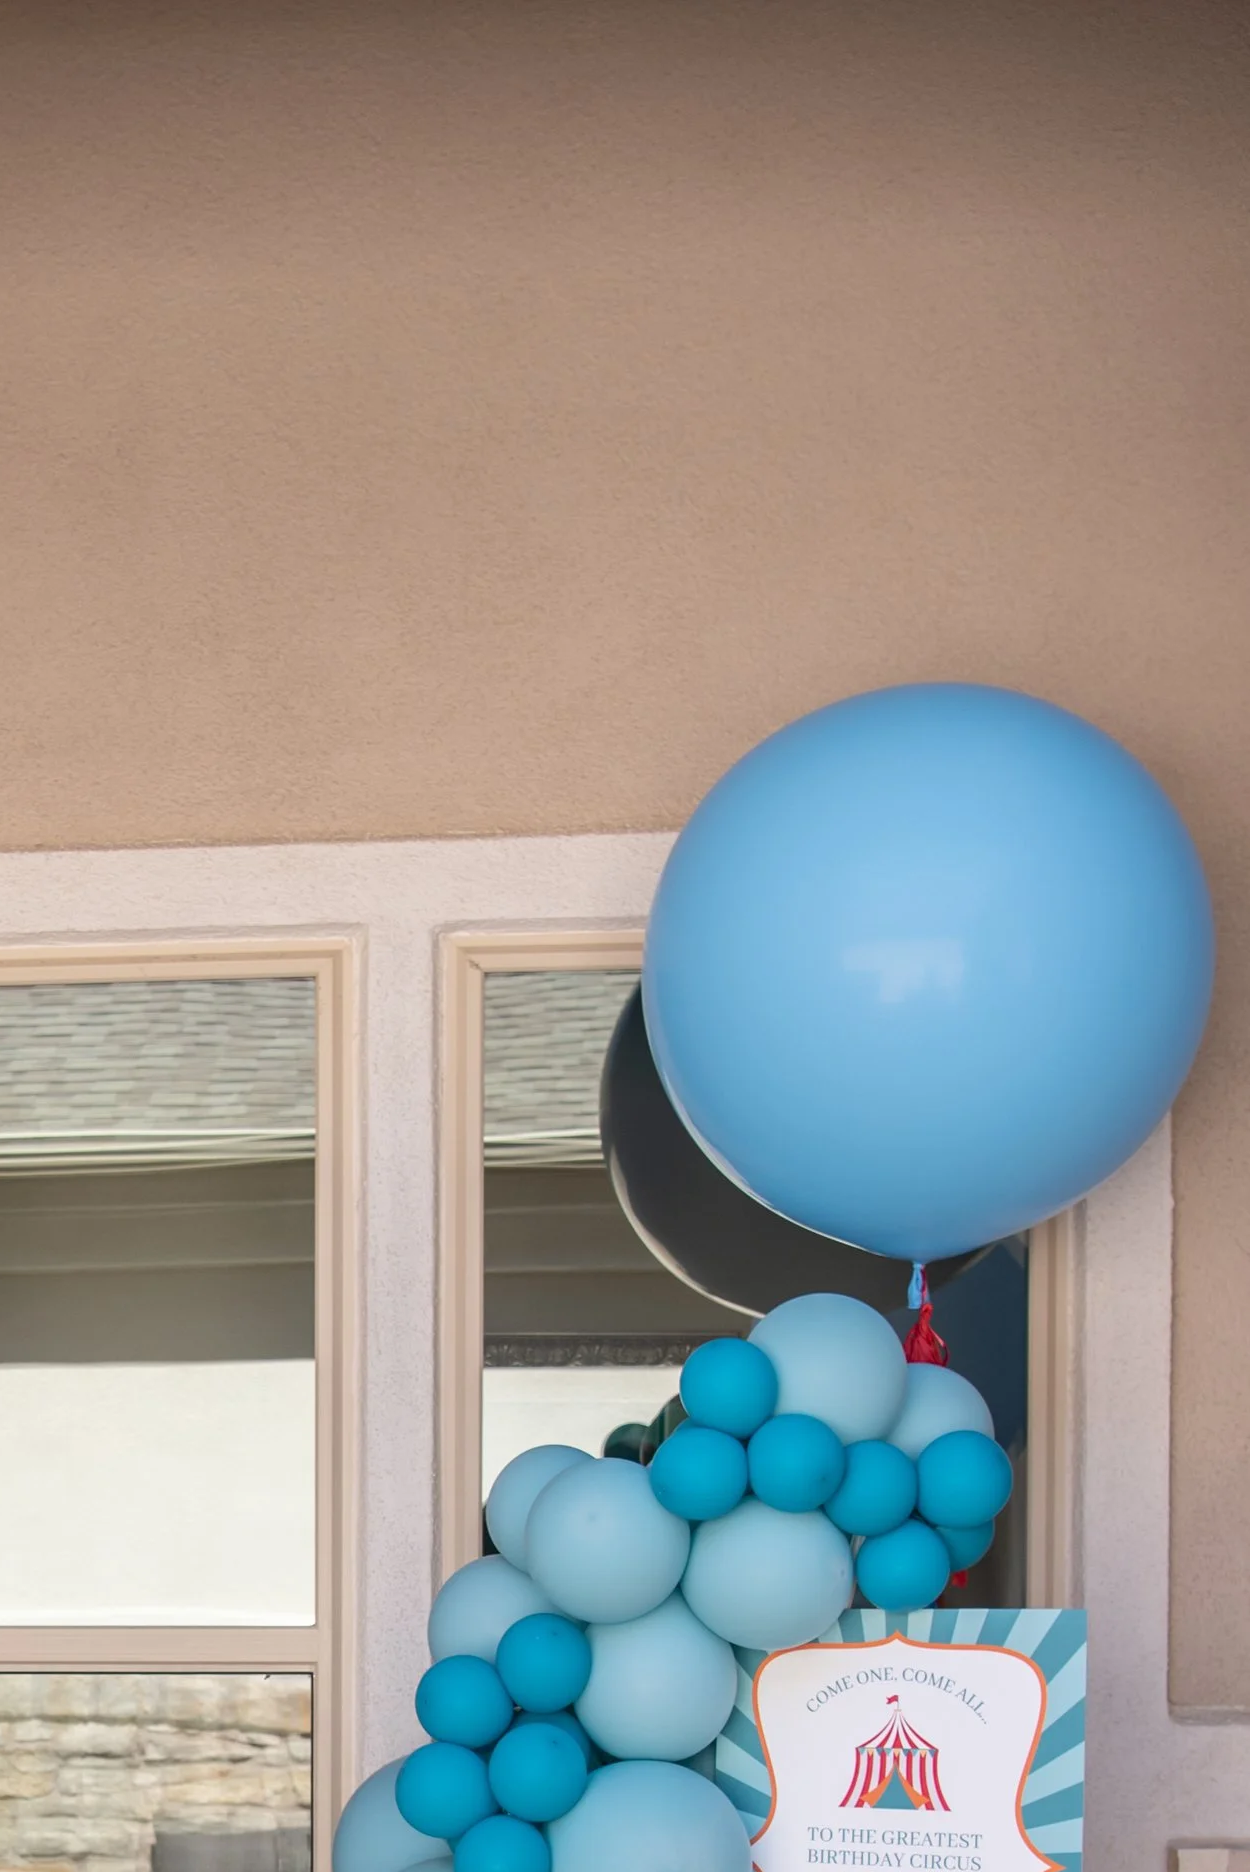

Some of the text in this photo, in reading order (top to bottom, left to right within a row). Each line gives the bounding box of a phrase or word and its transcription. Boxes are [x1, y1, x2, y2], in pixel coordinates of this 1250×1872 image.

[806, 1675, 854, 1713] COME
[902, 1667, 956, 1694] COME
[807, 1826, 983, 1849] TO THE GREATEST
[807, 1848, 982, 1872] BIRTHDAY CIRCUS
